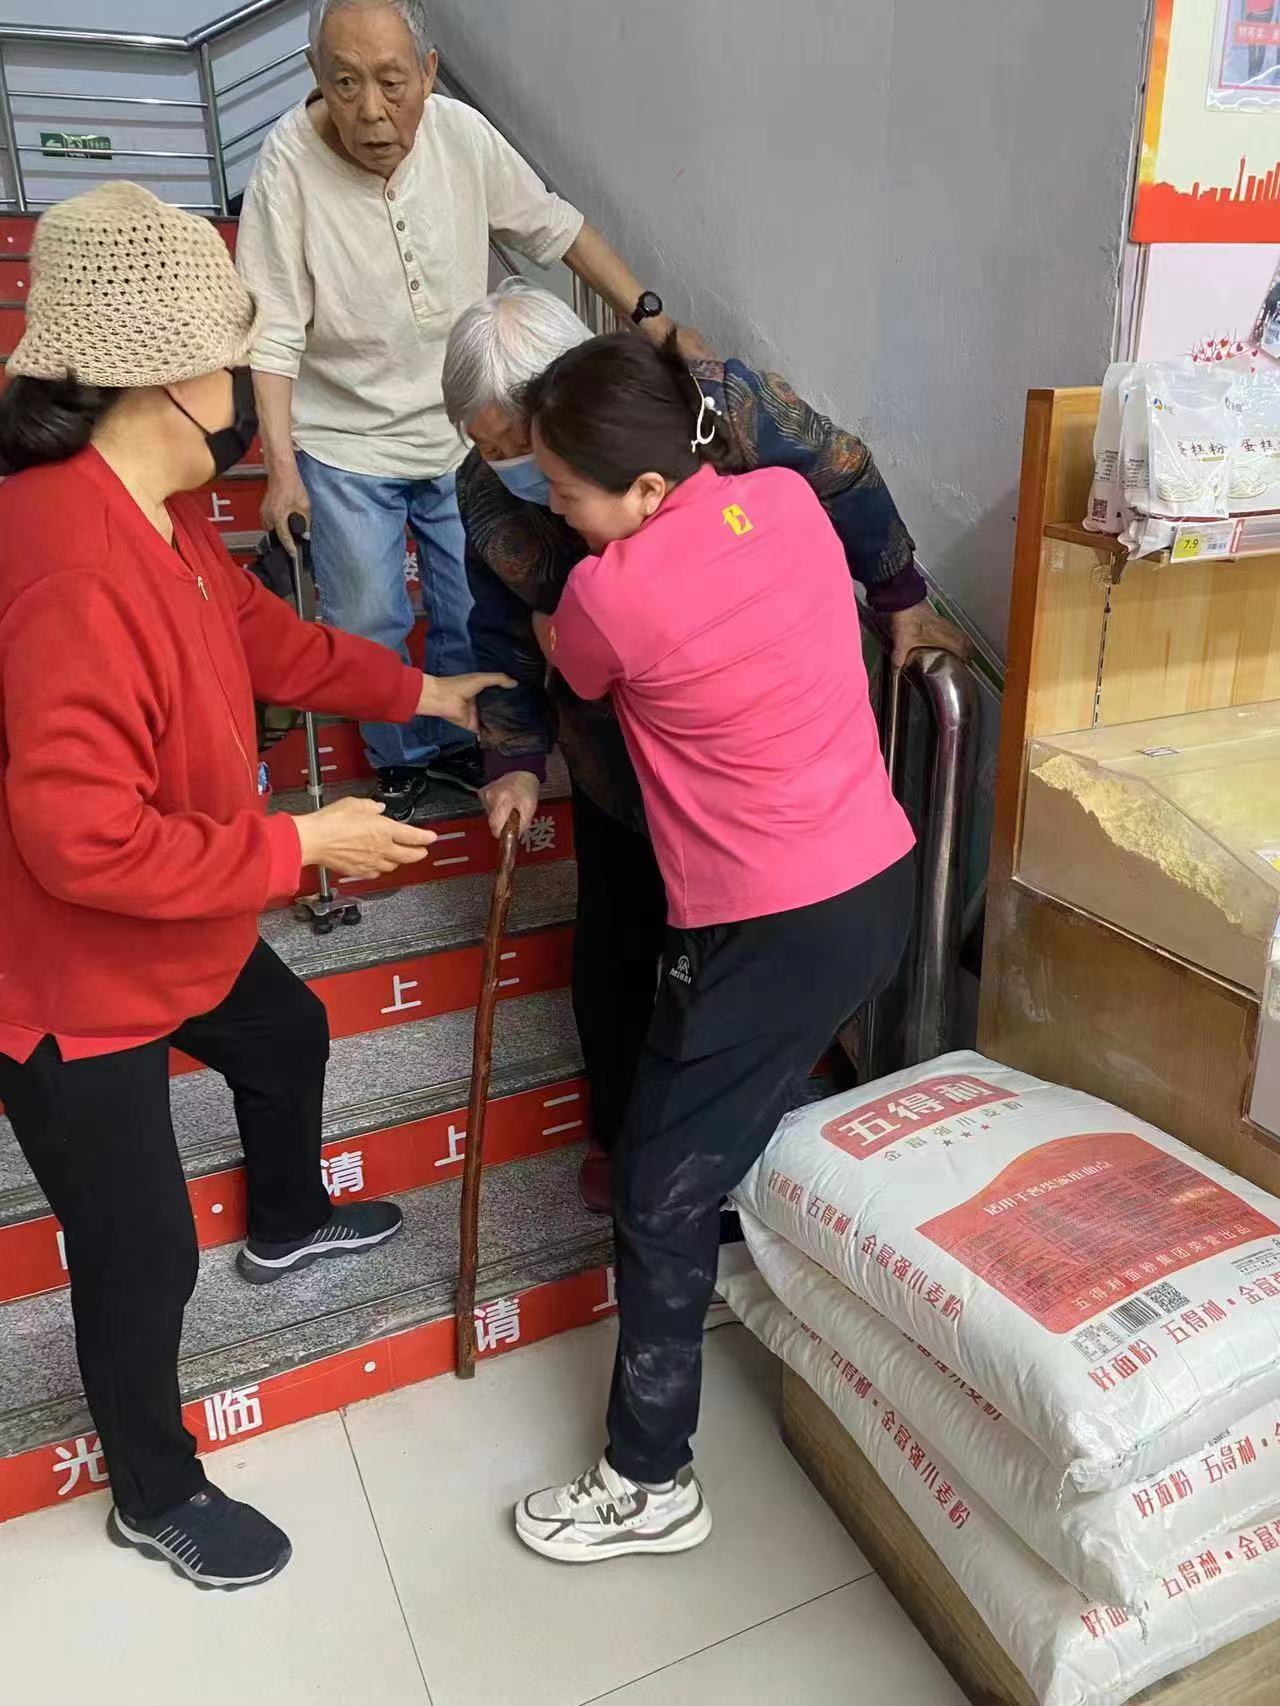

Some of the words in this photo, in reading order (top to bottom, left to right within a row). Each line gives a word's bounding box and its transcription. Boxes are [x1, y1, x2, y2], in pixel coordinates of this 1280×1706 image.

[207, 492, 234, 522] 上
[1183, 538, 1199, 550] 7.9
[520, 814, 555, 854] 楼
[380, 974, 422, 1014] 上
[320, 1150, 364, 1197] 请
[434, 1124, 467, 1167] 上
[542, 1092, 583, 1137] 二
[837, 1080, 995, 1147] 五得利
[767, 1168, 805, 1206] 好面粉
[807, 1194, 853, 1236] 五得利
[860, 1233, 966, 1322] 金富强小麦粉
[1073, 1223, 1252, 1312] 五得利面粉集团荣誉出品
[1088, 1338, 1159, 1393] 好面粉
[1159, 1298, 1228, 1345] 五得利
[52, 1437, 110, 1497] 光
[203, 1384, 264, 1442] 临
[474, 1298, 521, 1353] 请
[880, 1409, 972, 1530] 金富强小麦粉
[1131, 1468, 1194, 1519] 好面粉
[1200, 1435, 1257, 1484] 五得利
[1160, 1549, 1223, 1600] 五得利
